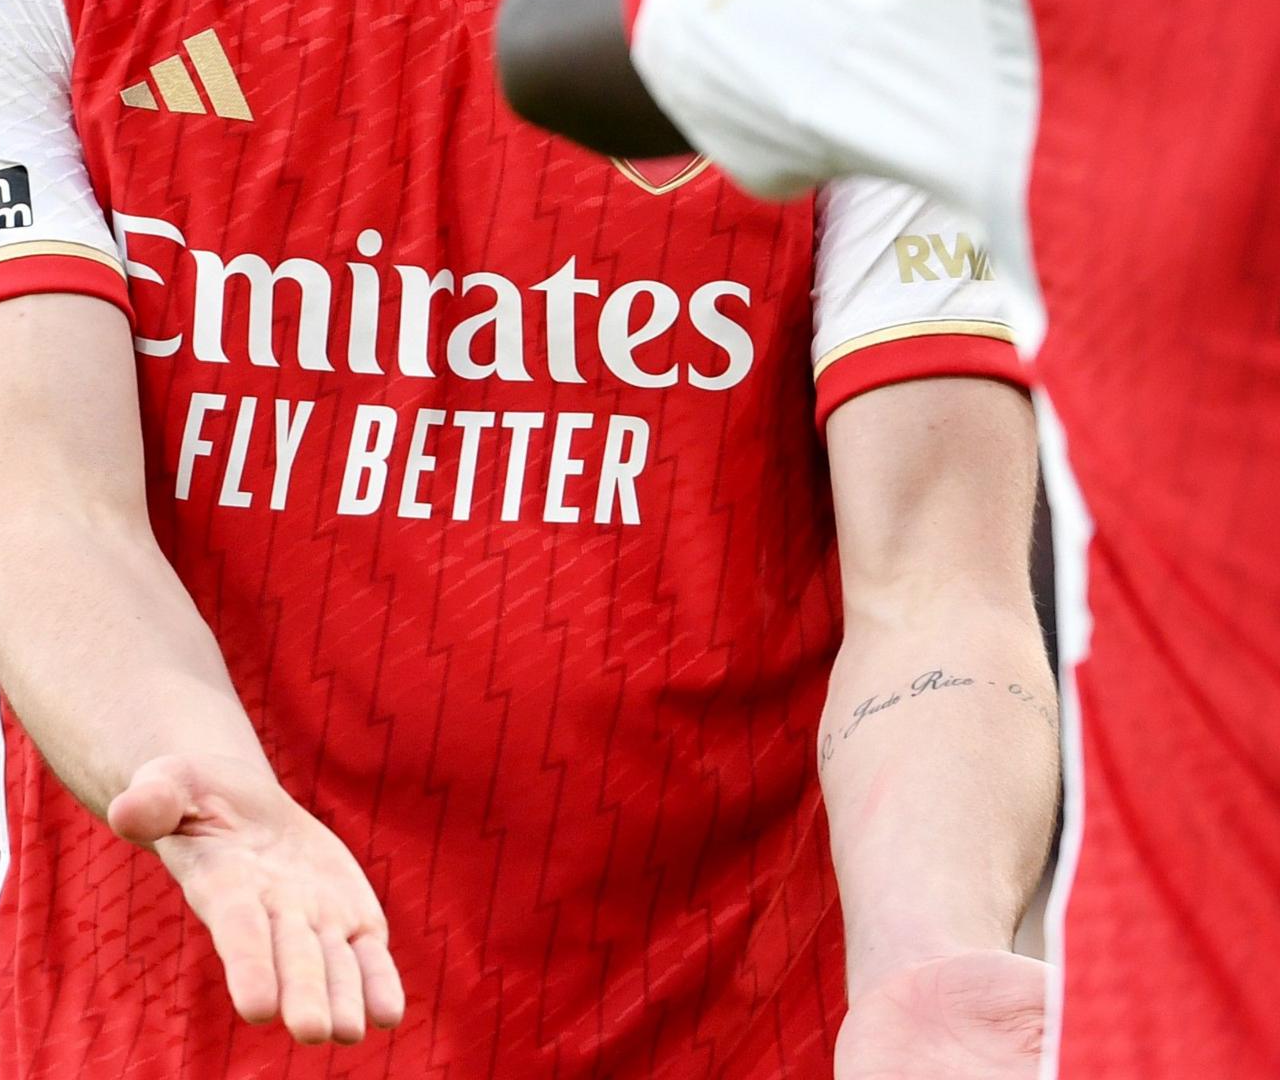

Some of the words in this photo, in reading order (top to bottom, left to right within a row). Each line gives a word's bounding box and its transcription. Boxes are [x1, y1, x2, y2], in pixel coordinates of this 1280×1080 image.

[112, 211, 754, 391] Emirates
[175, 393, 315, 512] FLY
[336, 404, 651, 525] BETTER
